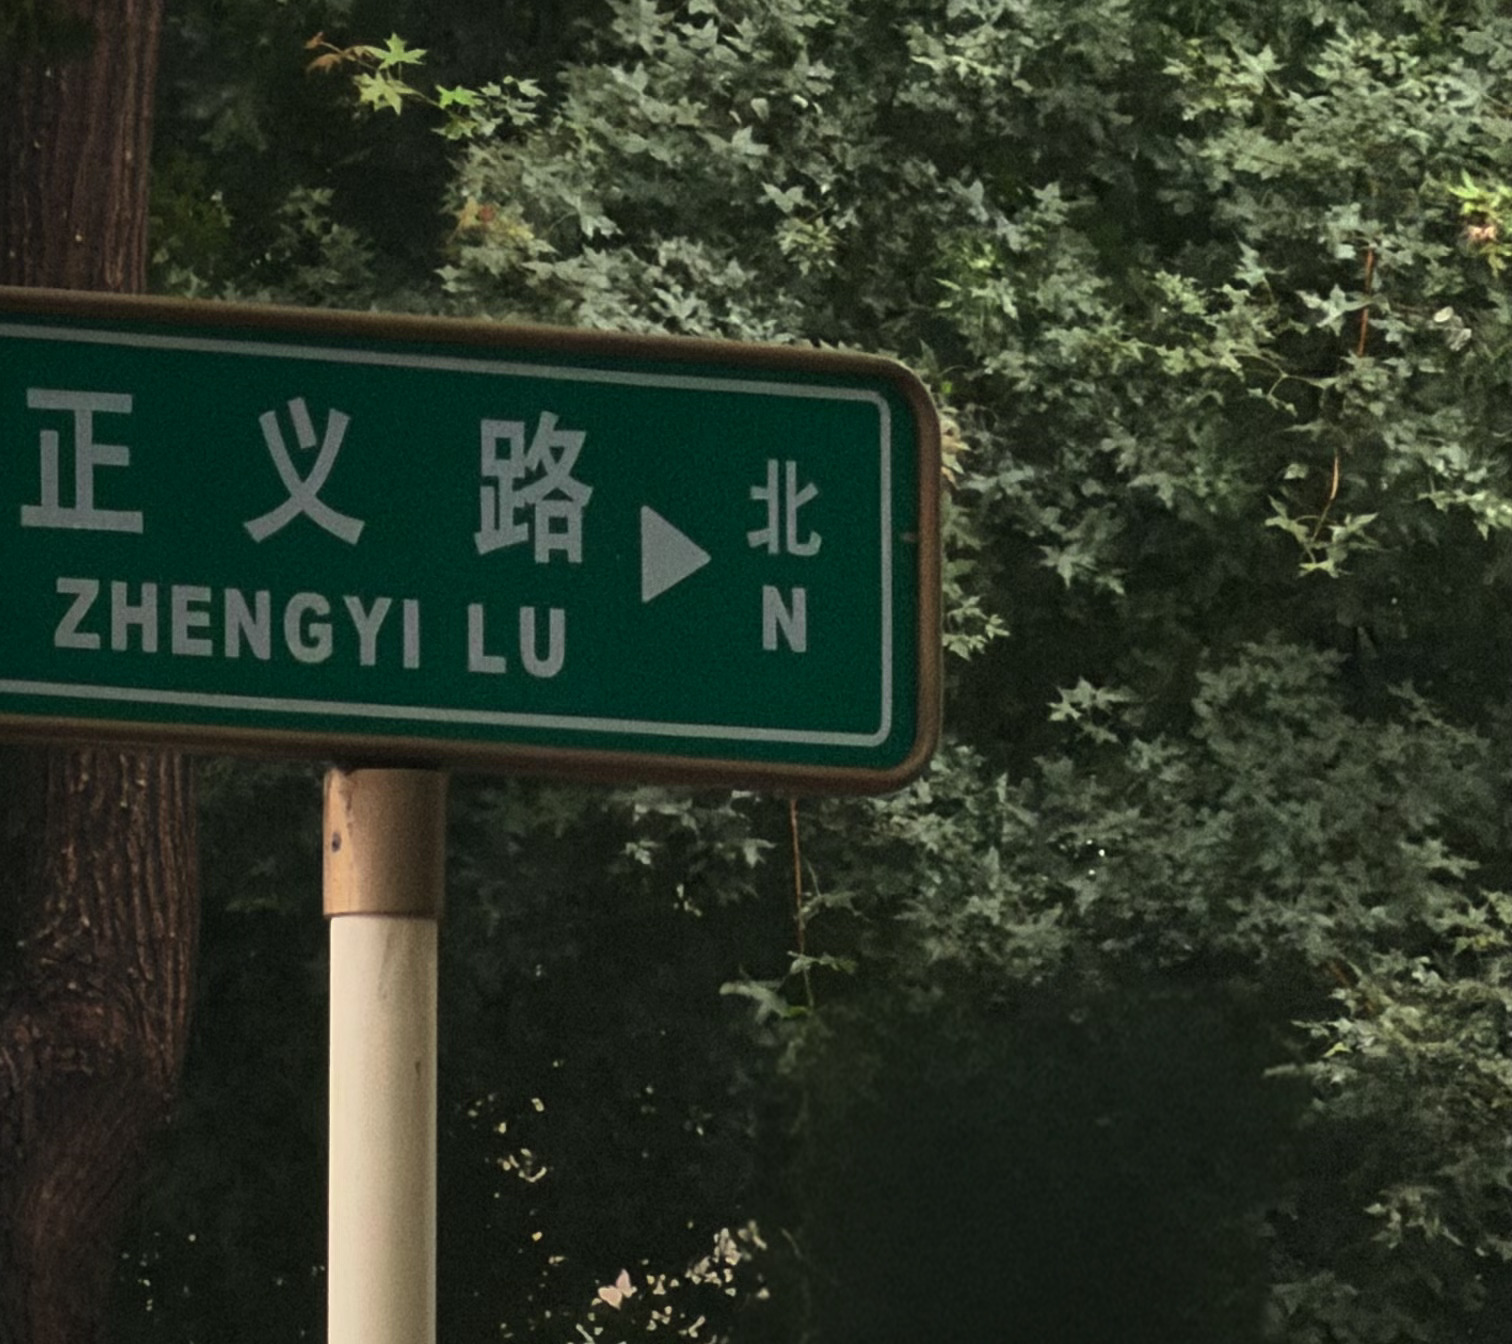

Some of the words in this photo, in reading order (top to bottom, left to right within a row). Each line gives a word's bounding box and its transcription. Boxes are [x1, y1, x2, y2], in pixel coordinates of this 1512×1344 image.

[20, 386, 594, 564] 正义路
[746, 458, 823, 557] 北
[54, 577, 421, 670] ZHENGYI
[467, 603, 567, 679] LU
[761, 584, 808, 654] N
